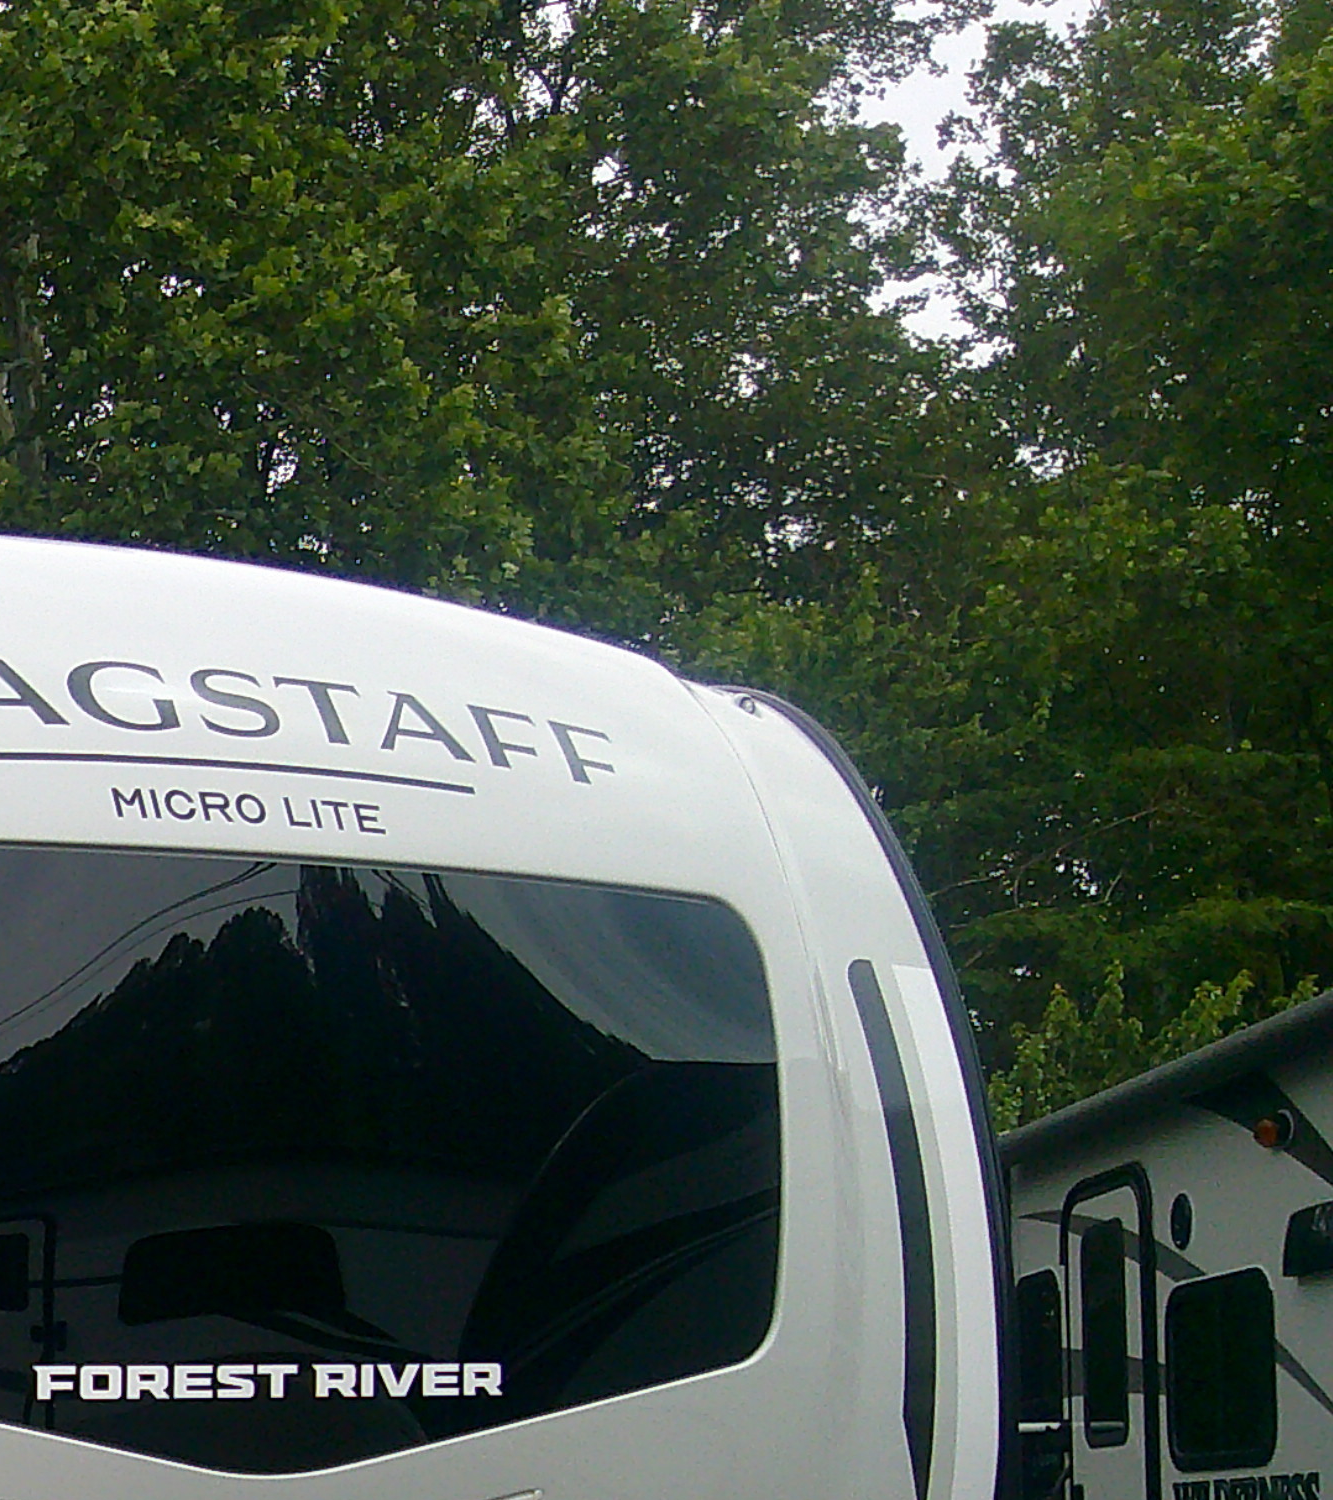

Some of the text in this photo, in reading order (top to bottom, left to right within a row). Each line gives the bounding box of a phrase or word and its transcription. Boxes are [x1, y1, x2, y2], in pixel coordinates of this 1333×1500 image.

[110, 786, 388, 835] MICRO LITE
[32, 1362, 503, 1400] FOREST RIVER
